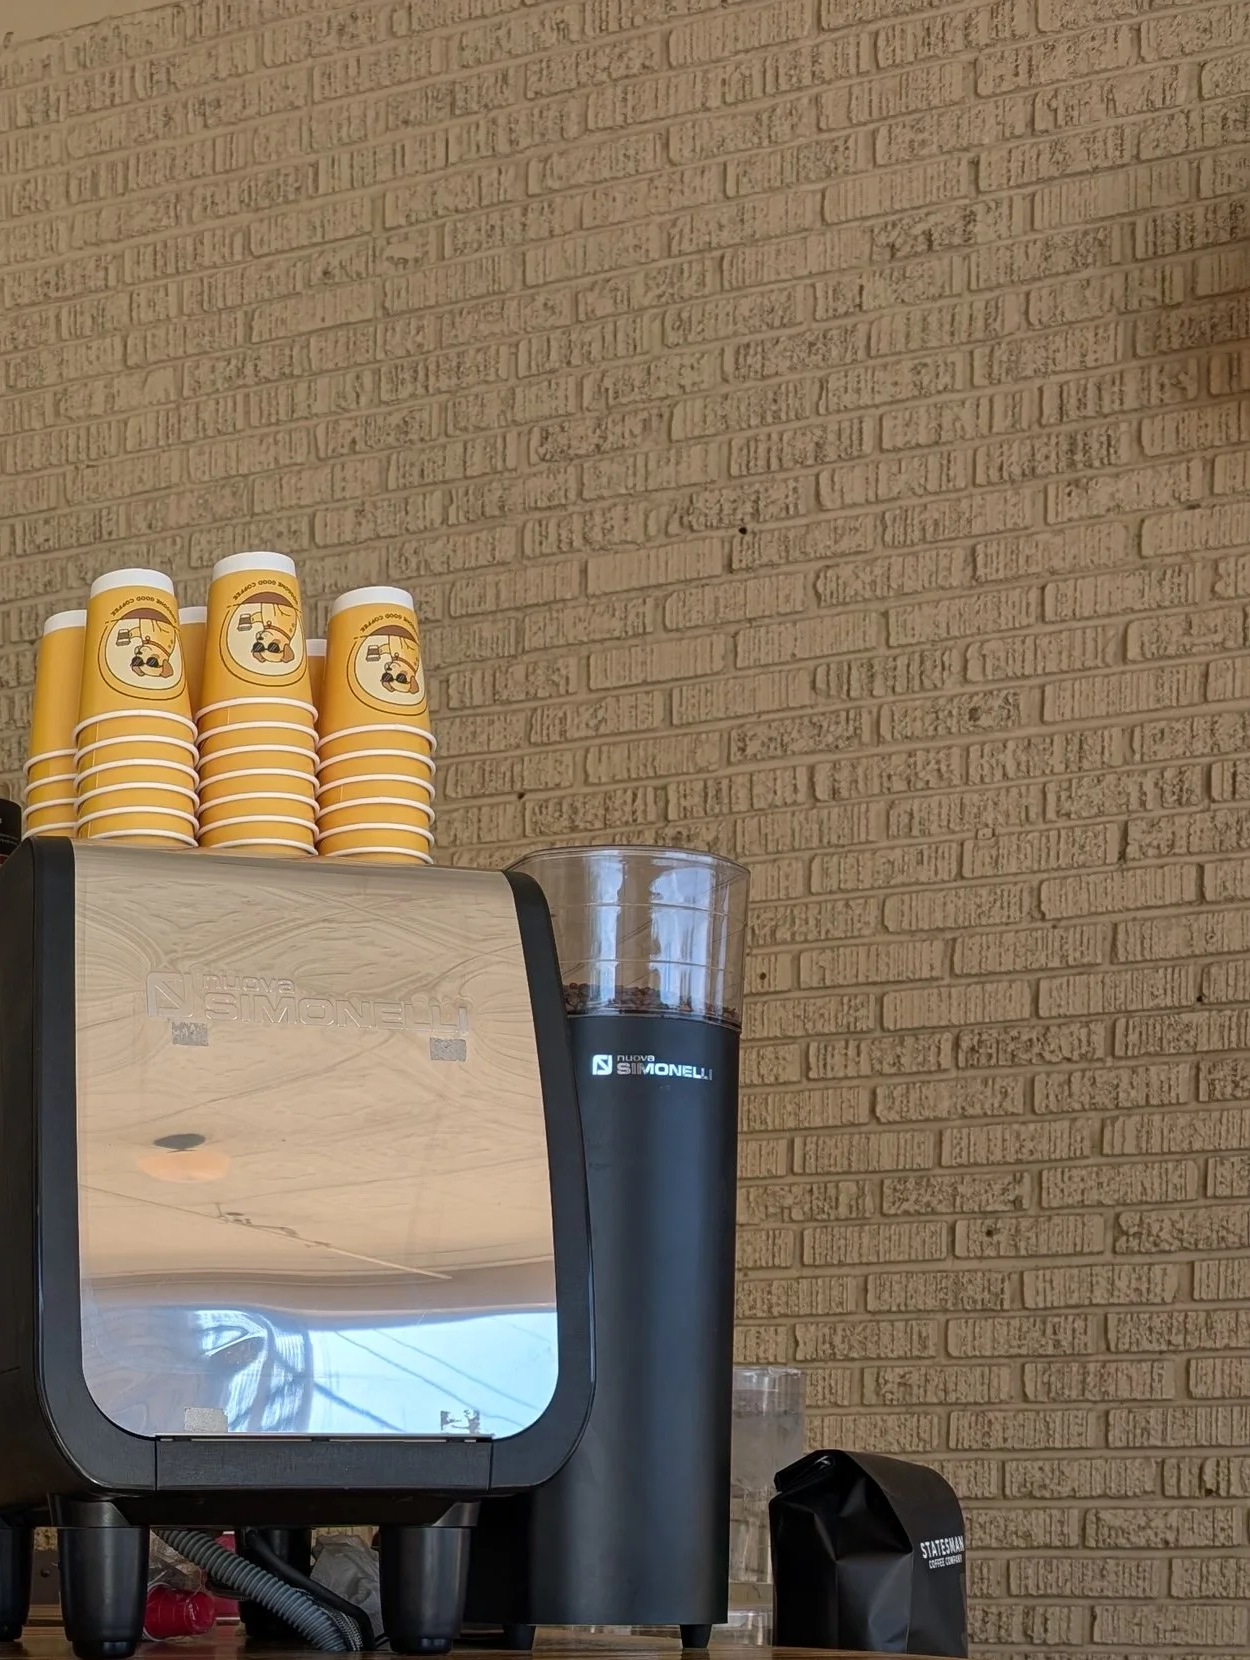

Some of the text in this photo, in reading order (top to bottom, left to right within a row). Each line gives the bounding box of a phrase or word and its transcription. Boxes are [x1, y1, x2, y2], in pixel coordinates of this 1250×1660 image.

[233, 582, 256, 600] COFFEE
[110, 598, 134, 616] COFFEE
[201, 973, 295, 994] nuova
[205, 992, 468, 1036] SIMONELLI
[616, 1062, 713, 1081] SIMONELLI
[920, 1535, 964, 1559] STATESMAN
[928, 1557, 945, 1569] COFFEE
